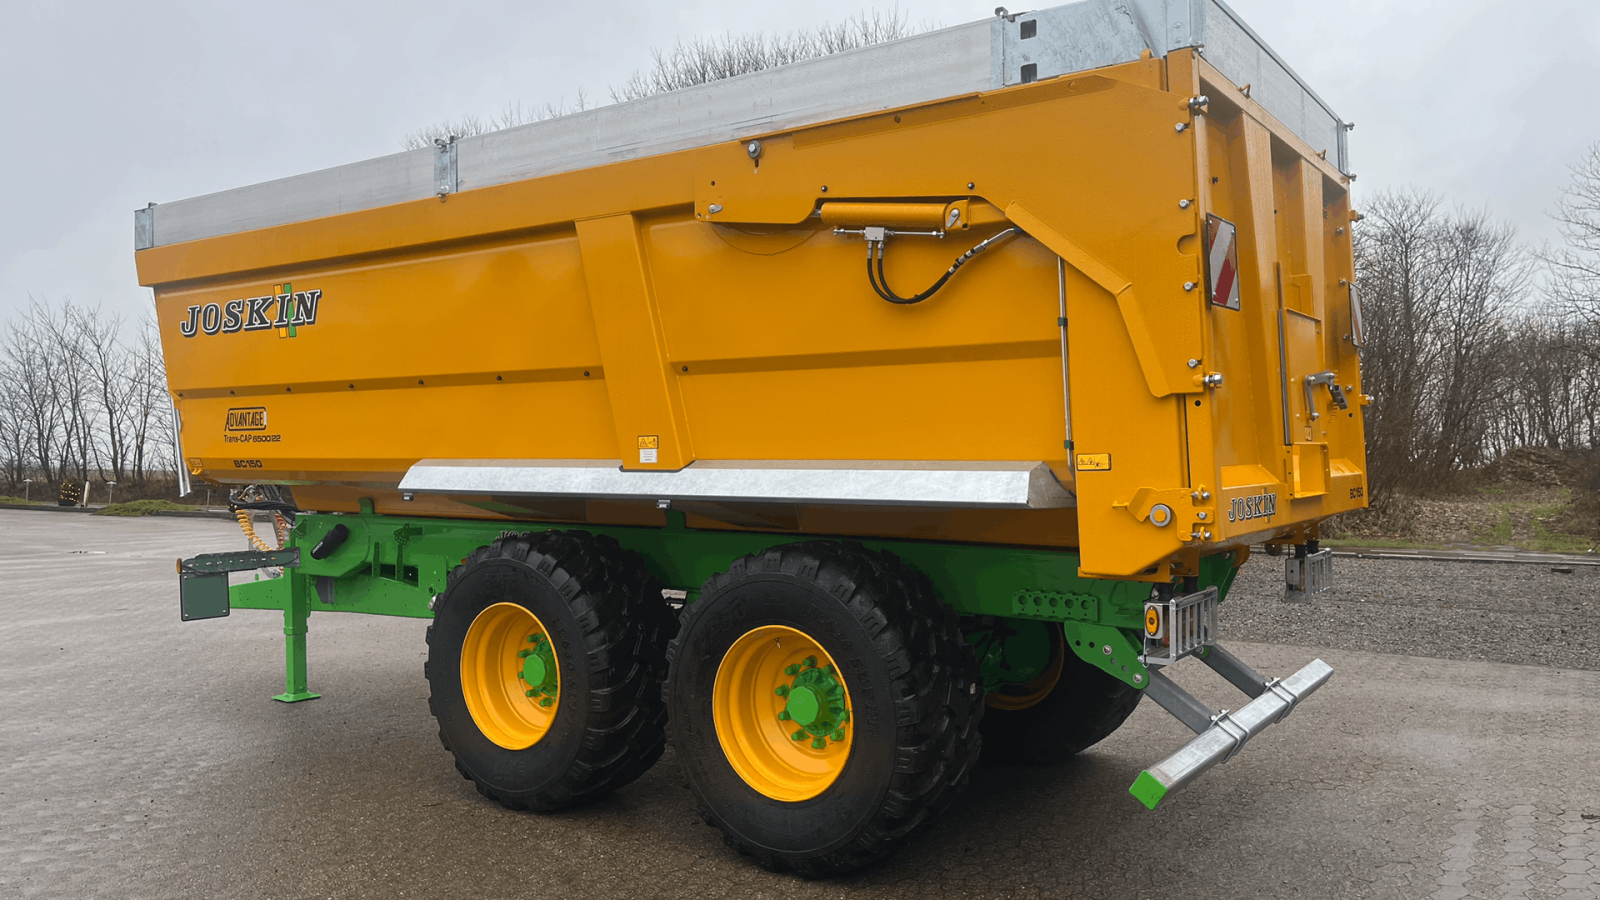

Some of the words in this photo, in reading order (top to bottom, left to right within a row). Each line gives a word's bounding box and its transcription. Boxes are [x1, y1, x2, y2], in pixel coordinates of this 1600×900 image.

[180, 289, 322, 338] JOSKIN
[224, 411, 264, 431] ADVANTAGE
[223, 434, 252, 443] Trans-CAP
[233, 460, 263, 468] BC150
[1228, 493, 1277, 523] JOSKIN
